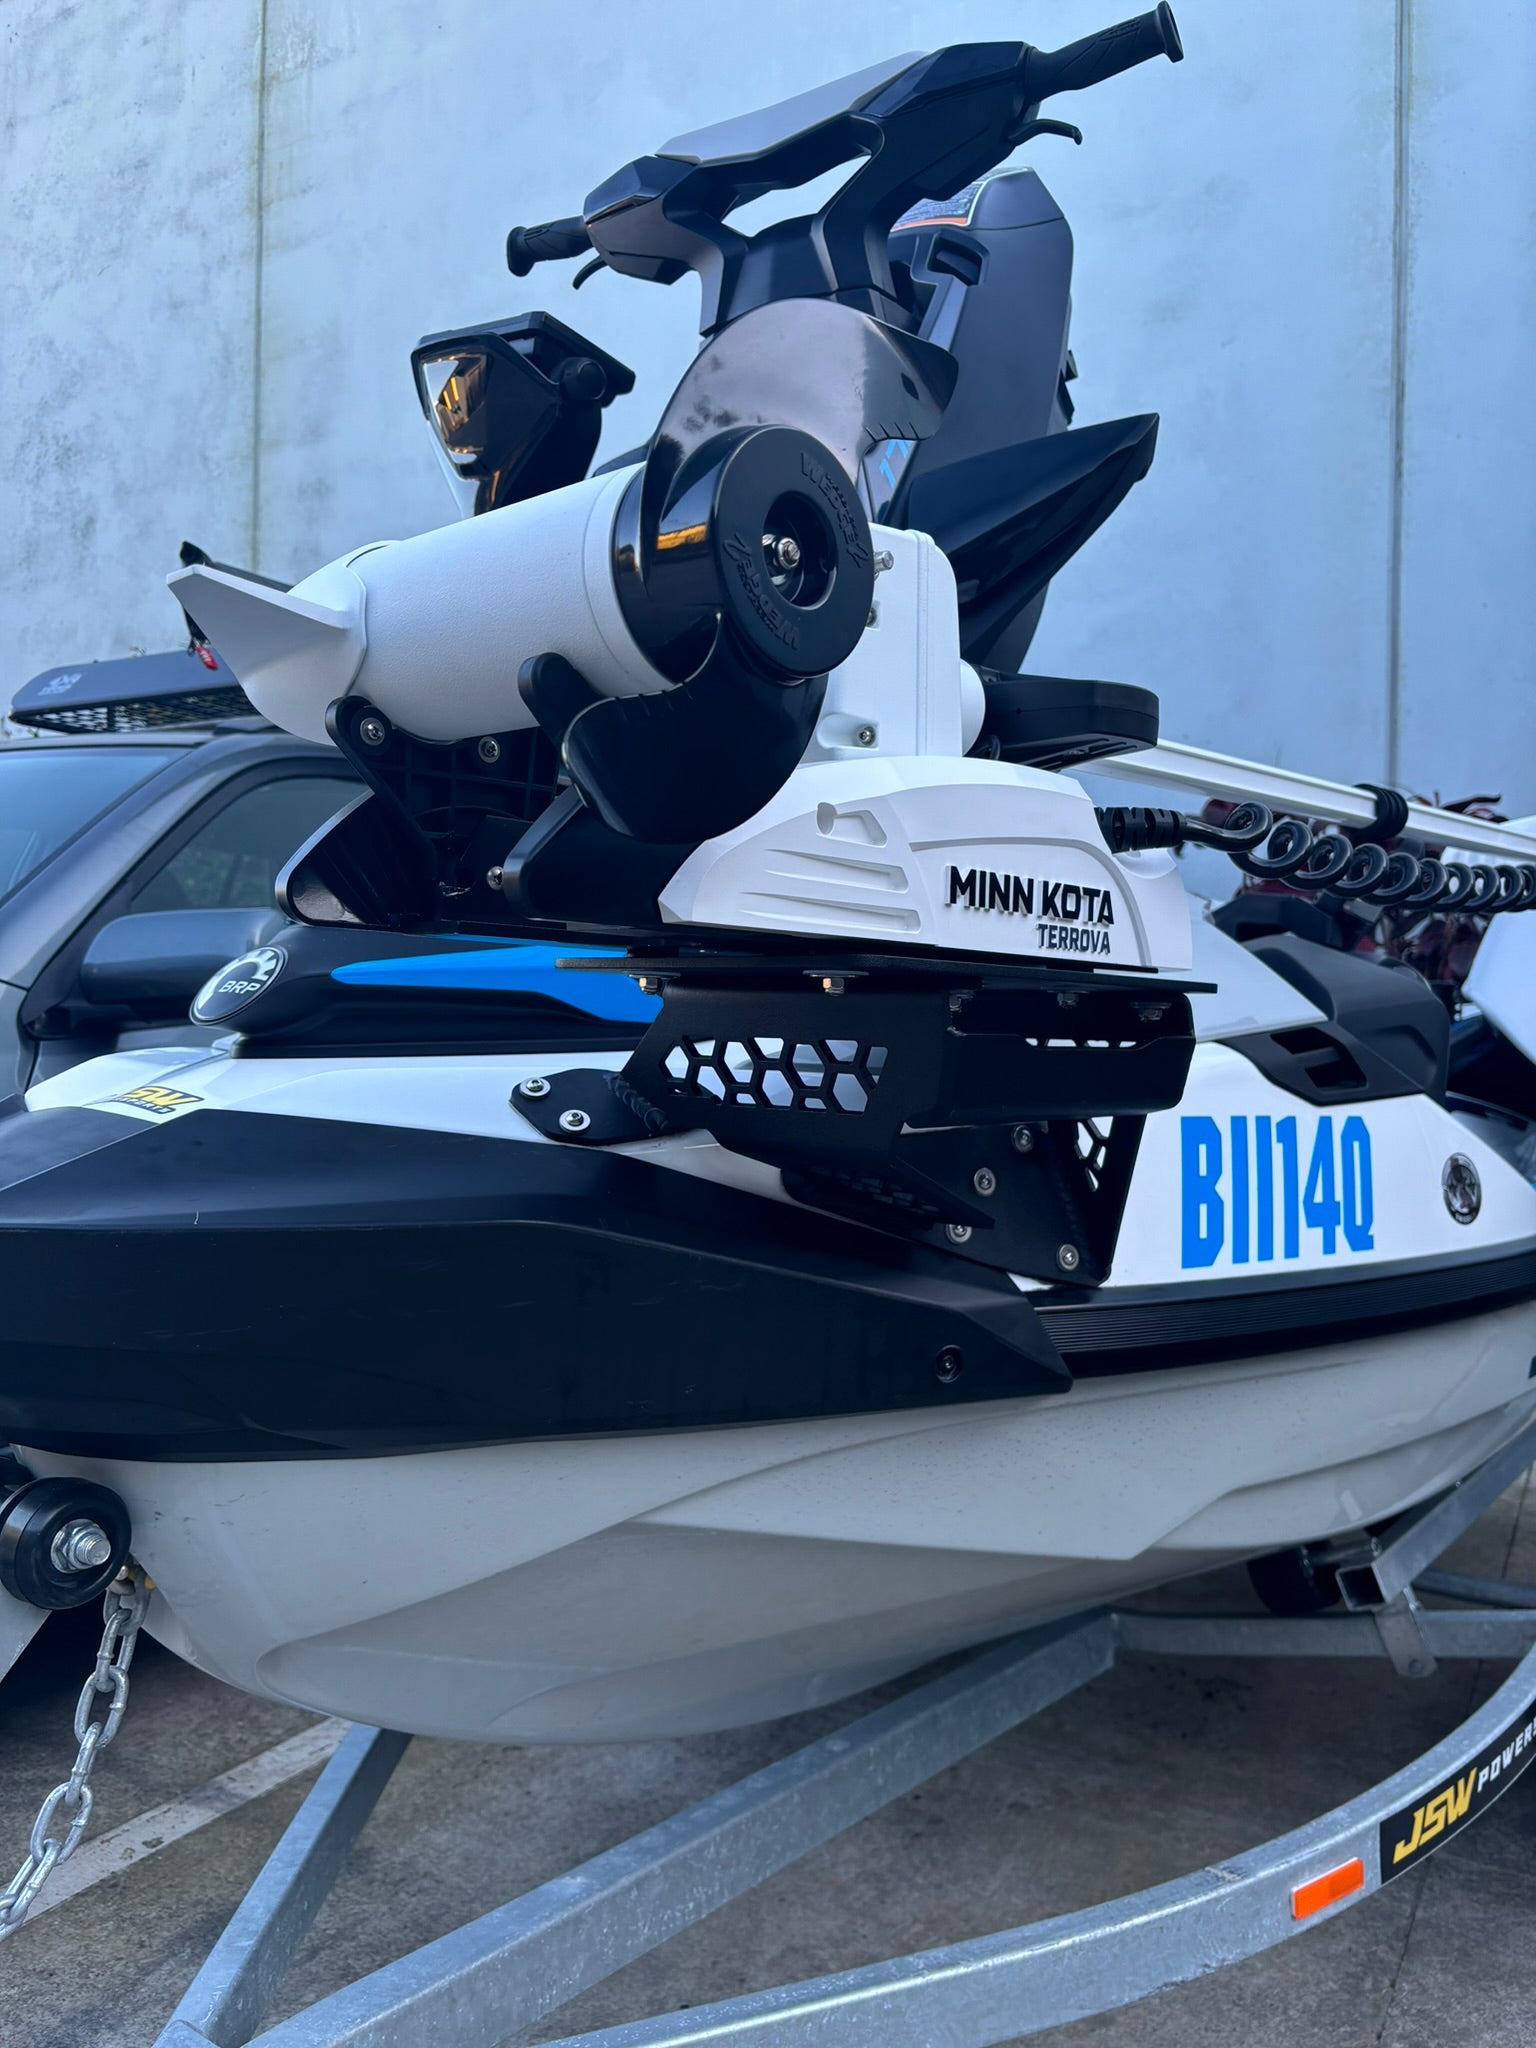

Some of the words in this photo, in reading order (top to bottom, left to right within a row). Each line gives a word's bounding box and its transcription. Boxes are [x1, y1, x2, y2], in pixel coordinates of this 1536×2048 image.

[800, 452, 859, 546] WEDGE
[946, 864, 1035, 915] MINN
[1037, 879, 1115, 926] KOTA
[1036, 922, 1111, 955] TERROVA
[218, 980, 261, 994] BRP
[1392, 1766, 1478, 1865] JSW
